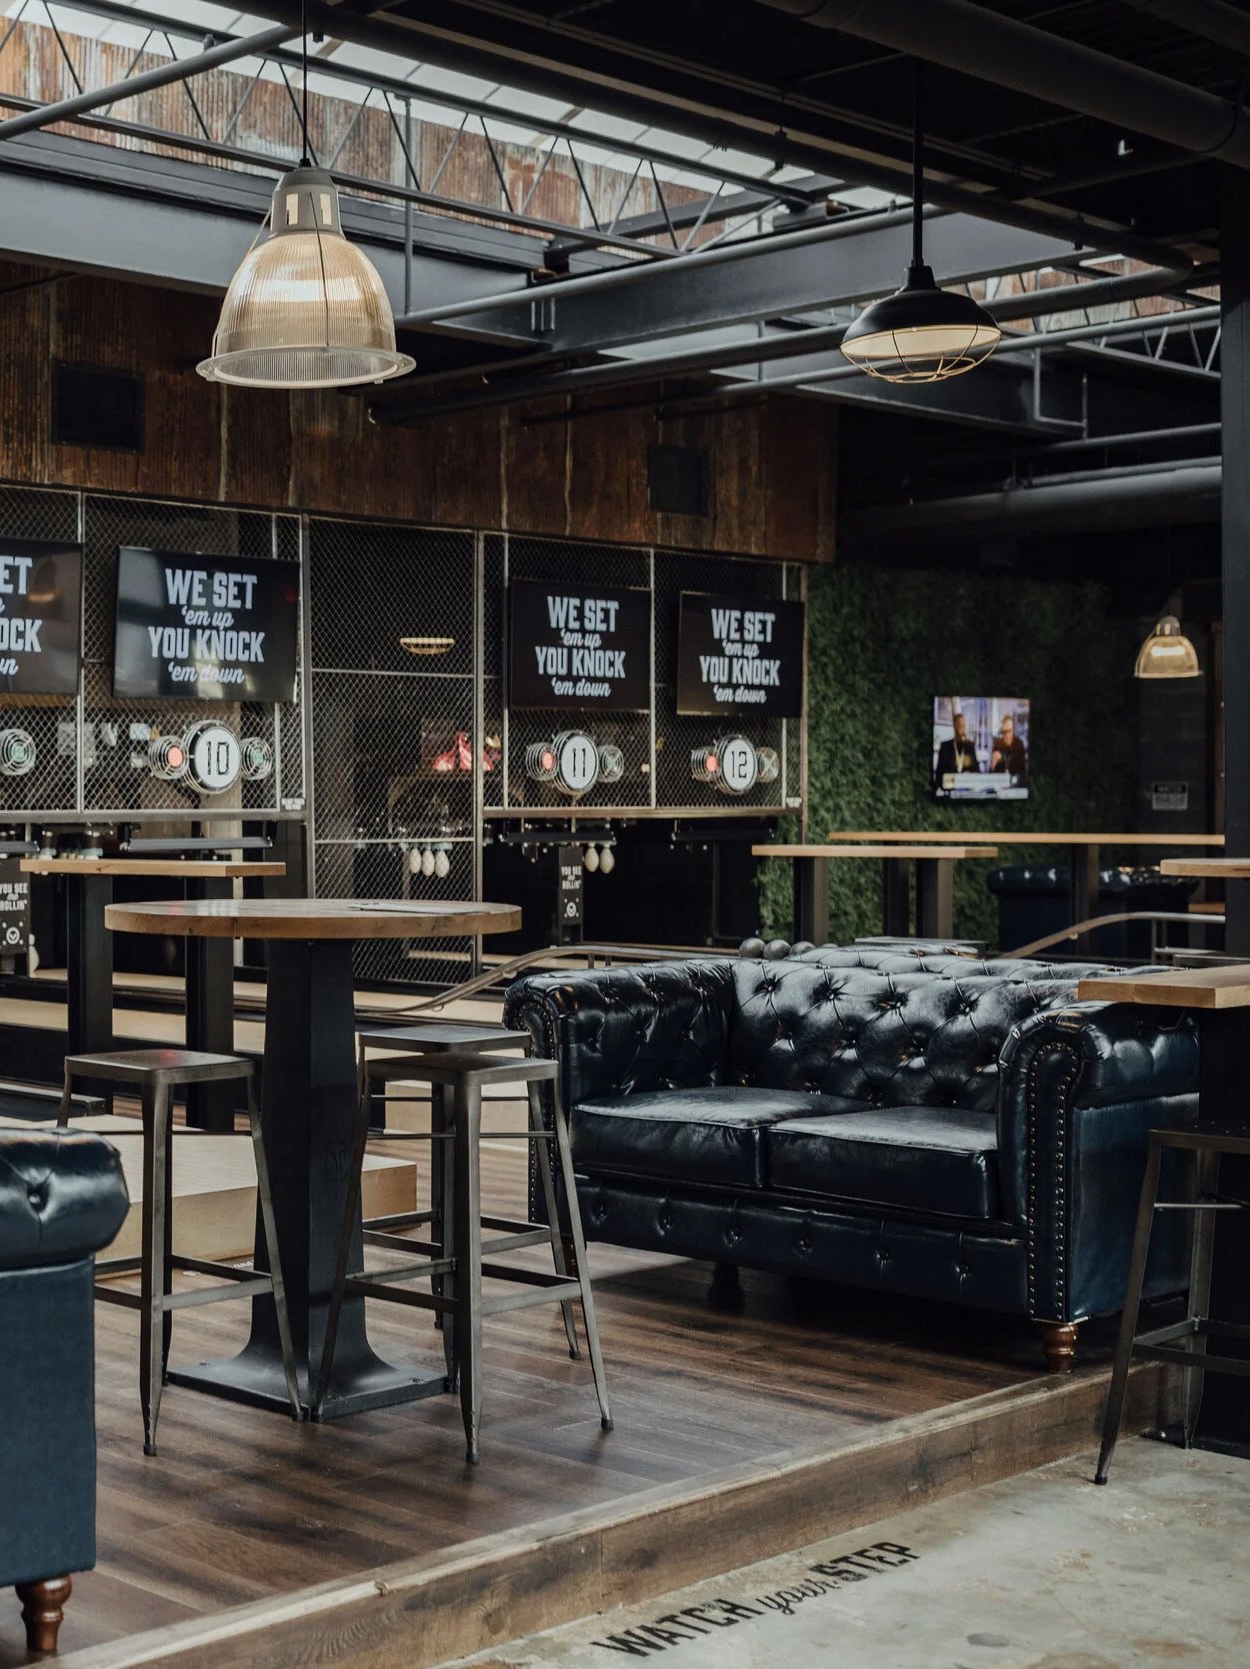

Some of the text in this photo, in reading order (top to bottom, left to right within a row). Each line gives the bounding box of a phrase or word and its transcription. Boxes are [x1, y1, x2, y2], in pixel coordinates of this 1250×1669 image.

[165, 568, 258, 609] WE SET
[211, 612, 234, 630] up
[547, 595, 619, 632] WE SET
[711, 608, 776, 643] WE SET
[148, 626, 265, 663] YOU KNOCK
[584, 633, 602, 650] up
[743, 643, 760, 660] up
[198, 664, 245, 684] down
[535, 646, 626, 678] YOU KNOCK
[699, 655, 781, 686] YOU KNOCK
[575, 678, 611, 697] down
[734, 685, 767, 704] down
[206, 741, 229, 775] 10
[572, 748, 586, 777] 11
[731, 750, 747, 778] 12
[590, 1541, 921, 1657] WATCH your STEP
